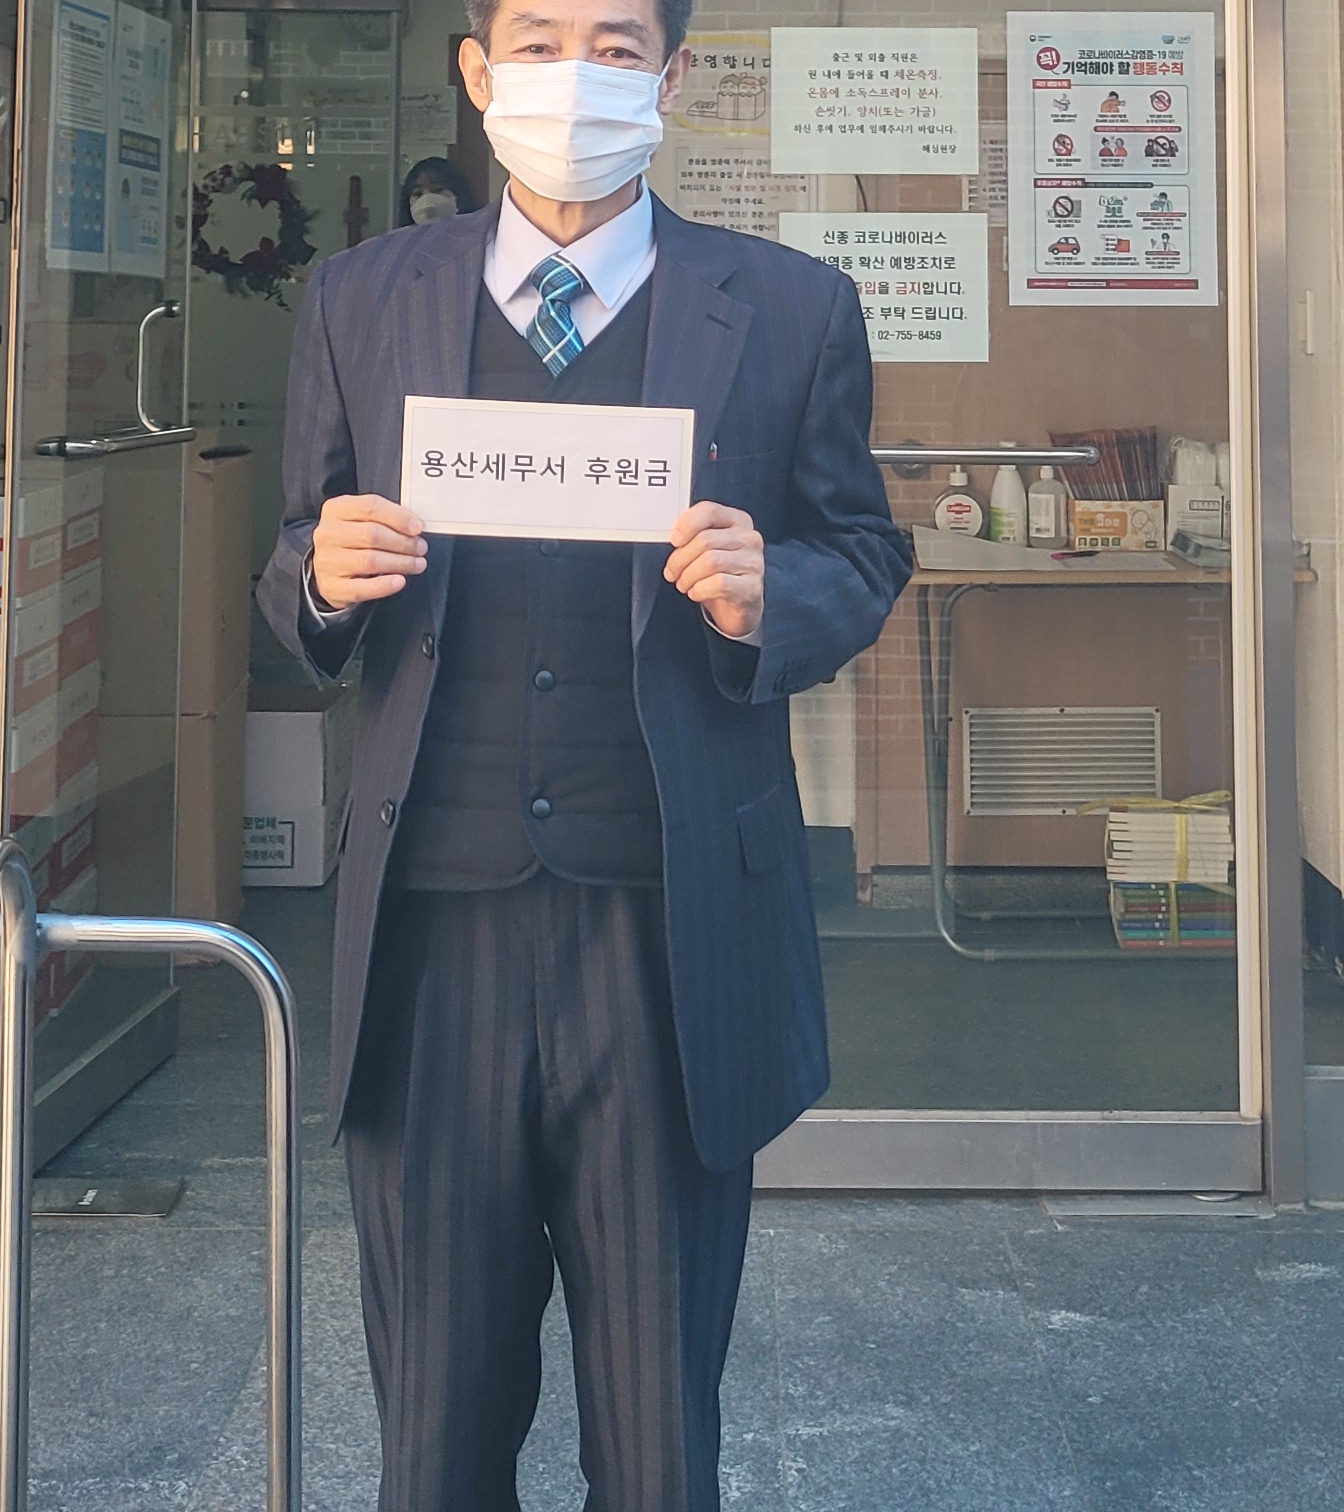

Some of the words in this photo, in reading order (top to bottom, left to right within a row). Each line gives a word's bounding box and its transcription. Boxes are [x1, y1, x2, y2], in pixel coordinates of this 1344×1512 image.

[832, 53, 850, 63] 출근
[868, 53, 886, 63] 외출
[891, 53, 918, 63] 직원은
[822, 69, 841, 81] 내에
[846, 69, 874, 81] 들어올
[1062, 62, 1114, 76] 기억해야
[1118, 62, 1131, 76] 할
[1132, 62, 1184, 76] 행동수칙
[807, 87, 839, 99] 온몸에
[846, 87, 911, 99] 소독스프레이
[857, 105, 905, 118] 양치(또는
[910, 105, 936, 118] 가글)
[794, 124, 811, 134] 하신
[816, 124, 834, 134] 후에
[823, 231, 849, 245] 신종
[854, 231, 947, 245] 코로나바이러스
[859, 256, 885, 270] 확산
[890, 256, 956, 270] 예방조치로
[895, 281, 965, 295] 금지합니다.
[880, 307, 906, 320] 부탁
[911, 307, 968, 320] 드립니다.
[877, 330, 942, 341] 02-755-8459
[420, 450, 565, 484] 용산세무서
[584, 456, 671, 487] 후원금
